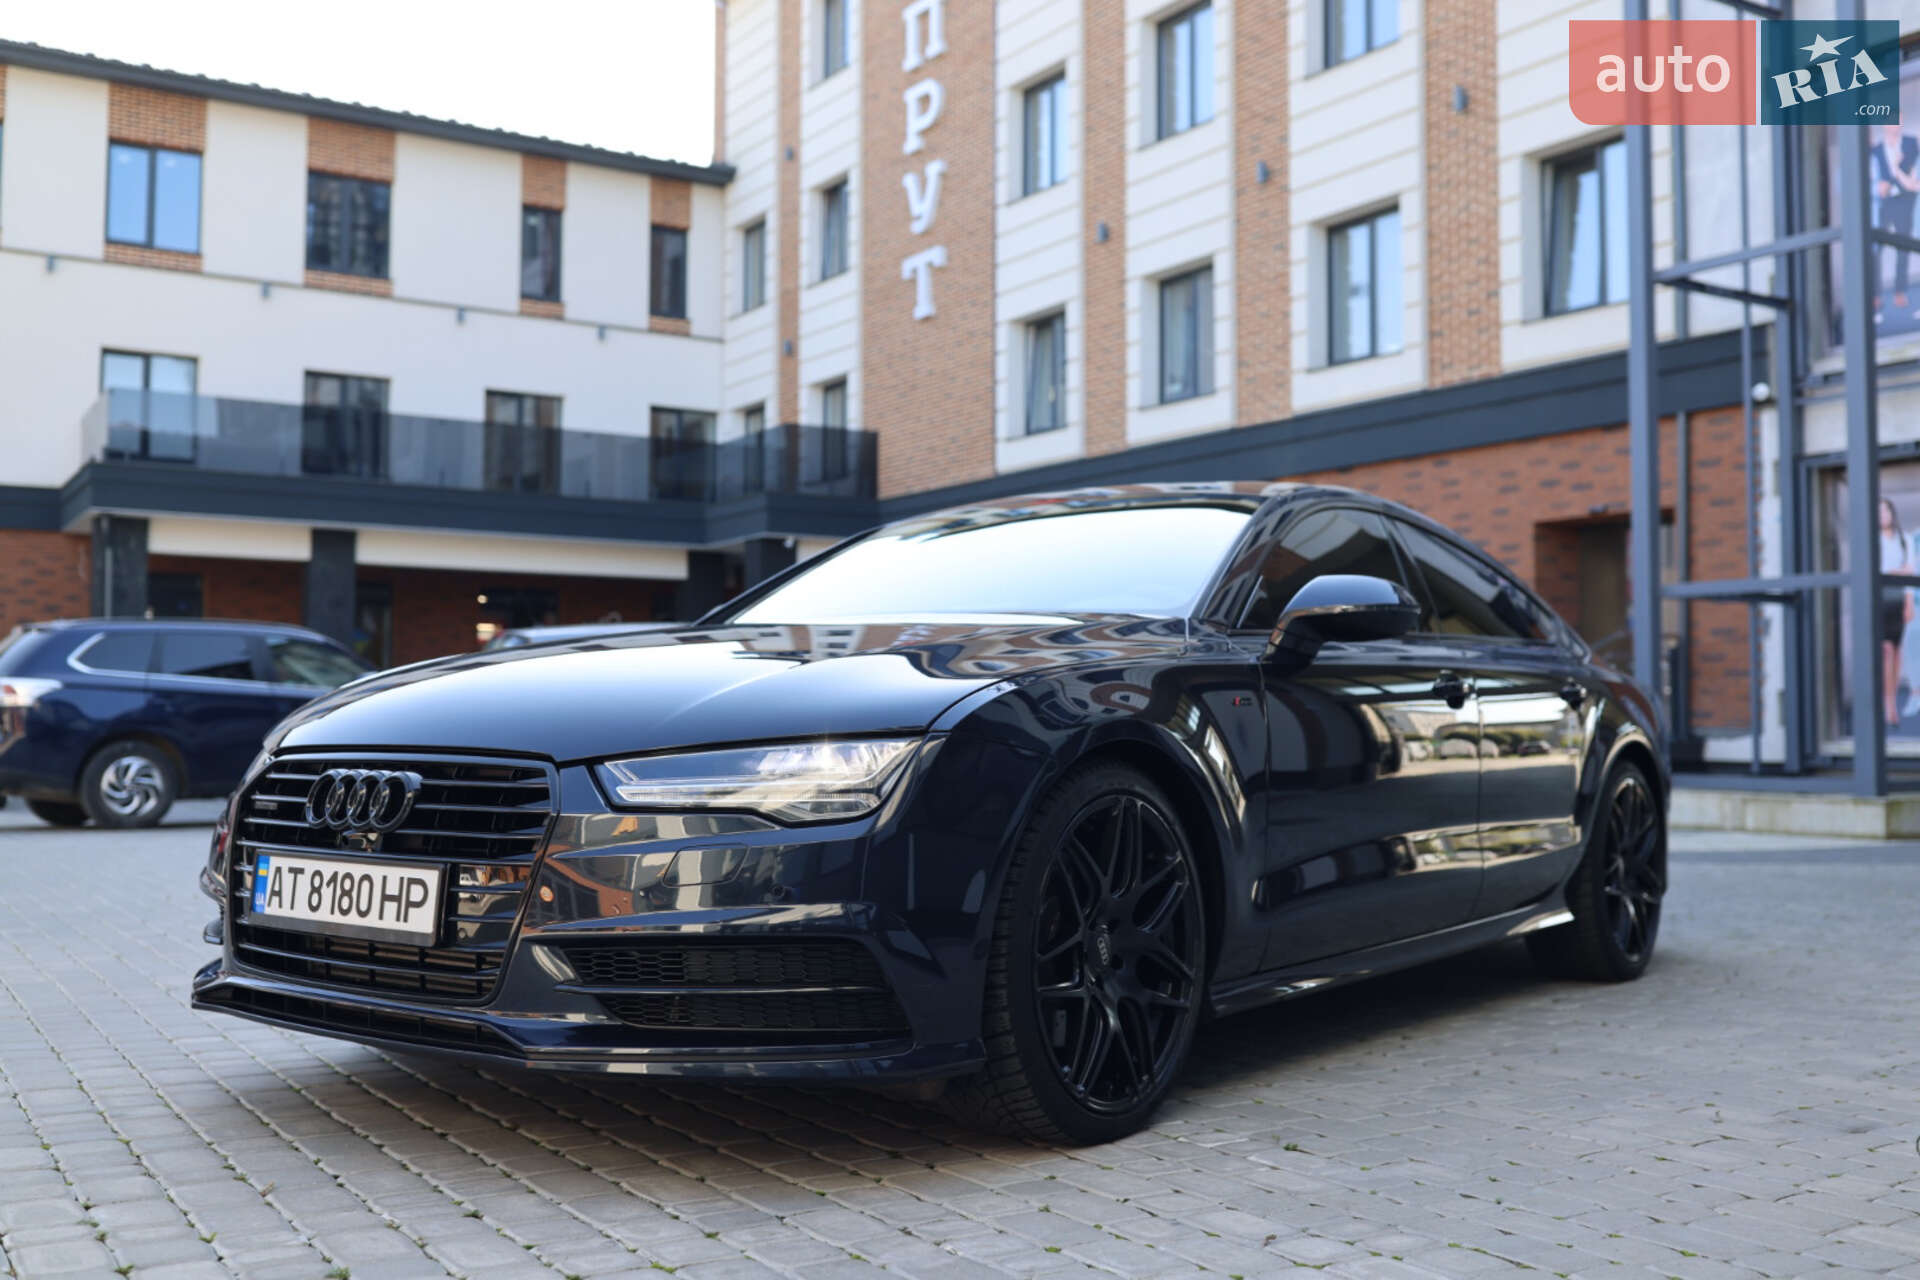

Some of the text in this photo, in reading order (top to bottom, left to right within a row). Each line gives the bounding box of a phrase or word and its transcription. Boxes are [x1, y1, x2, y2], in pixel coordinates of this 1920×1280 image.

[902, 0, 947, 321] ПРУТ
[267, 865, 429, 923] AT 8180 HP
